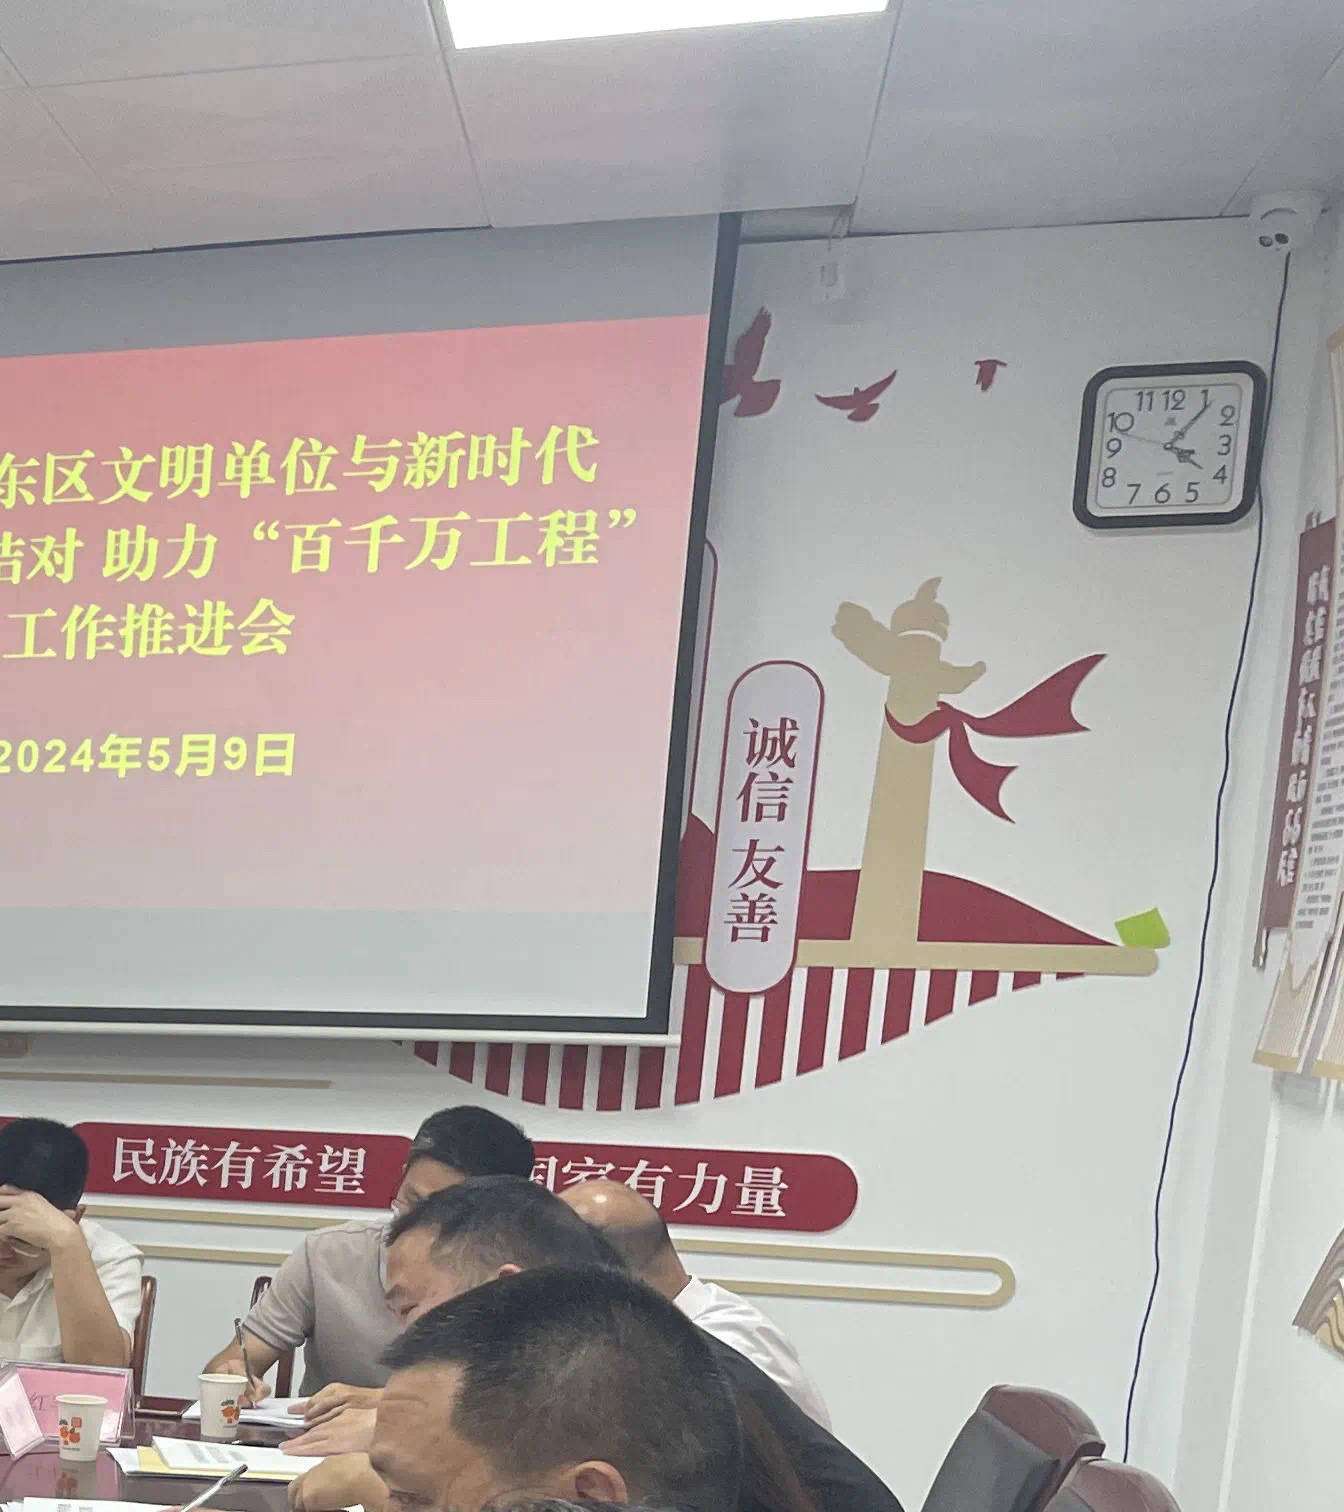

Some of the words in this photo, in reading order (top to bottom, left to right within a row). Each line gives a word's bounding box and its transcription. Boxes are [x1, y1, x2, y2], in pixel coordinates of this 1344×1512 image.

[1136, 391, 1154, 412] 11
[1162, 389, 1185, 411] 12
[1201, 389, 1209, 408] 1
[1107, 412, 1134, 432] 10
[1220, 405, 1235, 426] 2
[1106, 438, 1121, 458] 9
[1217, 434, 1232, 455] 3
[1101, 467, 1116, 488] 8
[1213, 465, 1227, 484] 4
[1127, 484, 1141, 504] 7
[1155, 483, 1170, 503] 6
[1185, 482, 1200, 503] 5
[1, 599, 296, 661] 工作推进会
[723, 716, 800, 945] 诚信友善
[112, 1137, 367, 1194] 民族有希望
